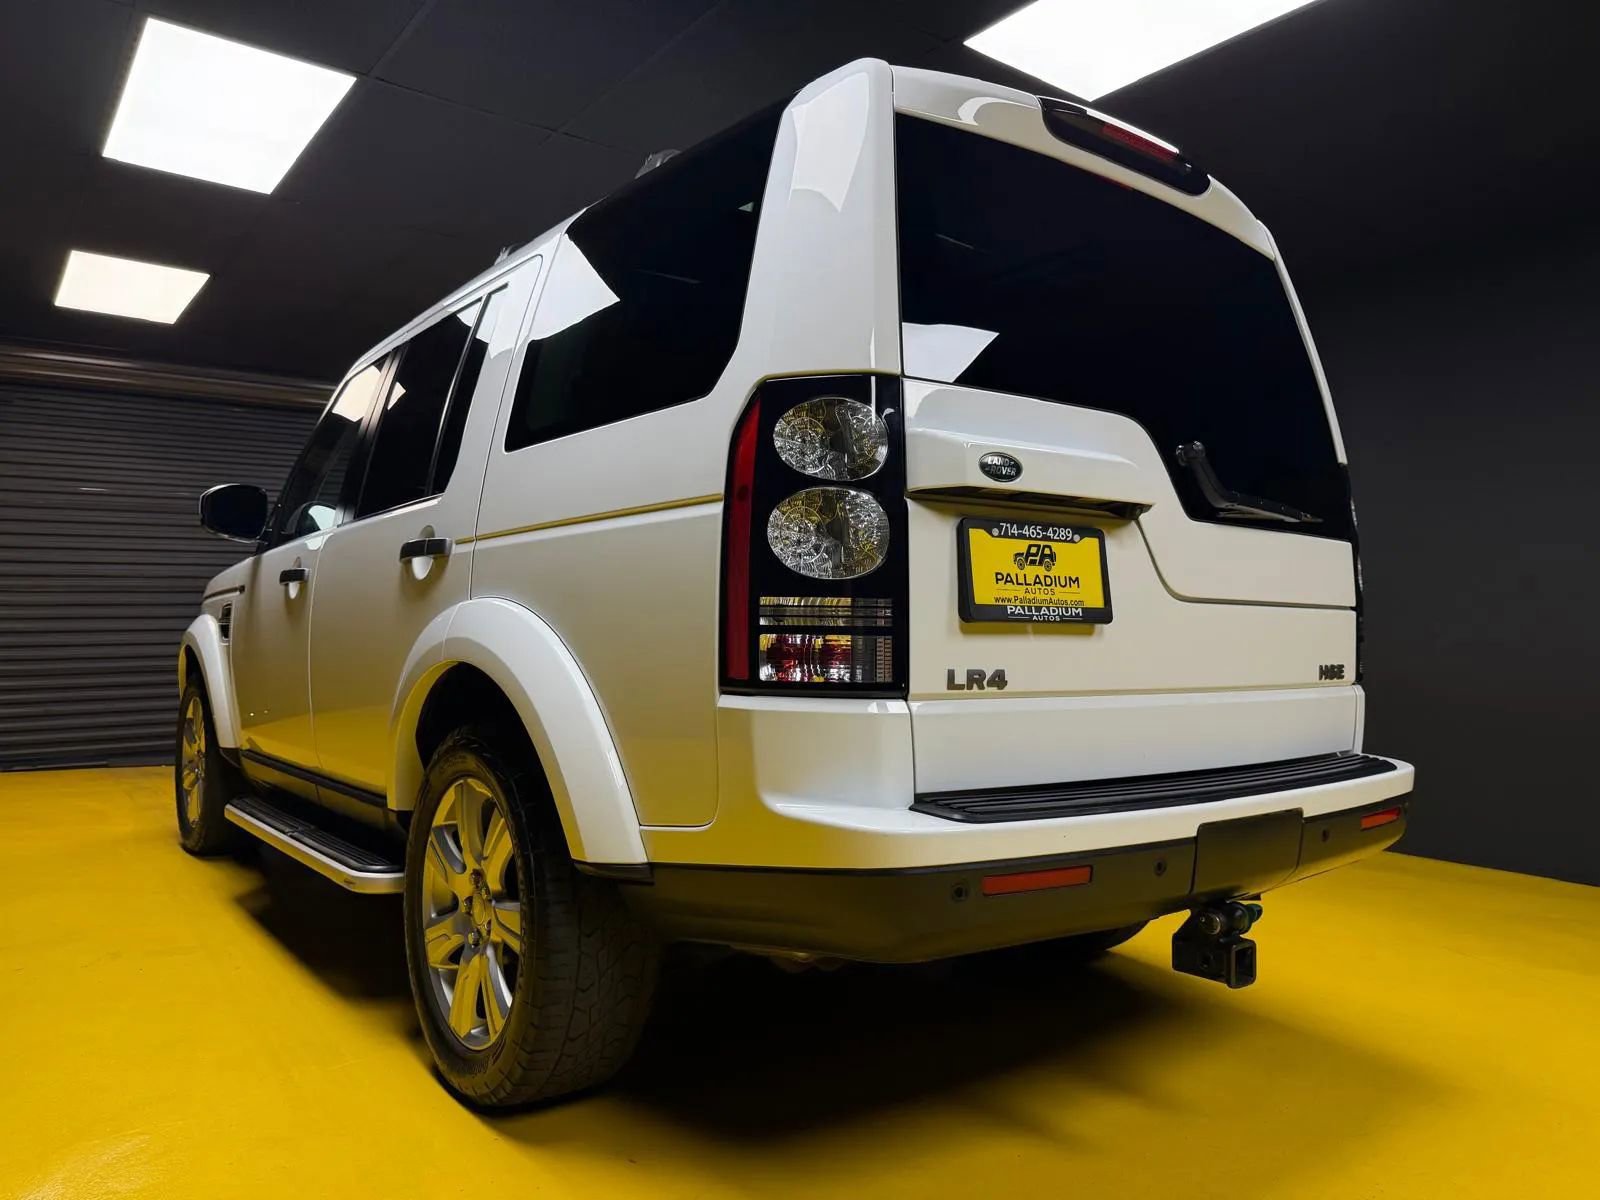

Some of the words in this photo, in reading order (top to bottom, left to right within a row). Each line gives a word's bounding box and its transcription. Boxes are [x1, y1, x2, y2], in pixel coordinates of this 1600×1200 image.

[990, 465, 1017, 476] ROVER
[1000, 523, 1073, 541] 714-465-4289
[994, 572, 1080, 588] PALLADIUM
[1024, 587, 1056, 595] AUTOS
[994, 595, 1085, 607] www.PalladiumAutos.com
[1007, 605, 1083, 616] PALLADIUM
[946, 668, 1008, 691] LR4
